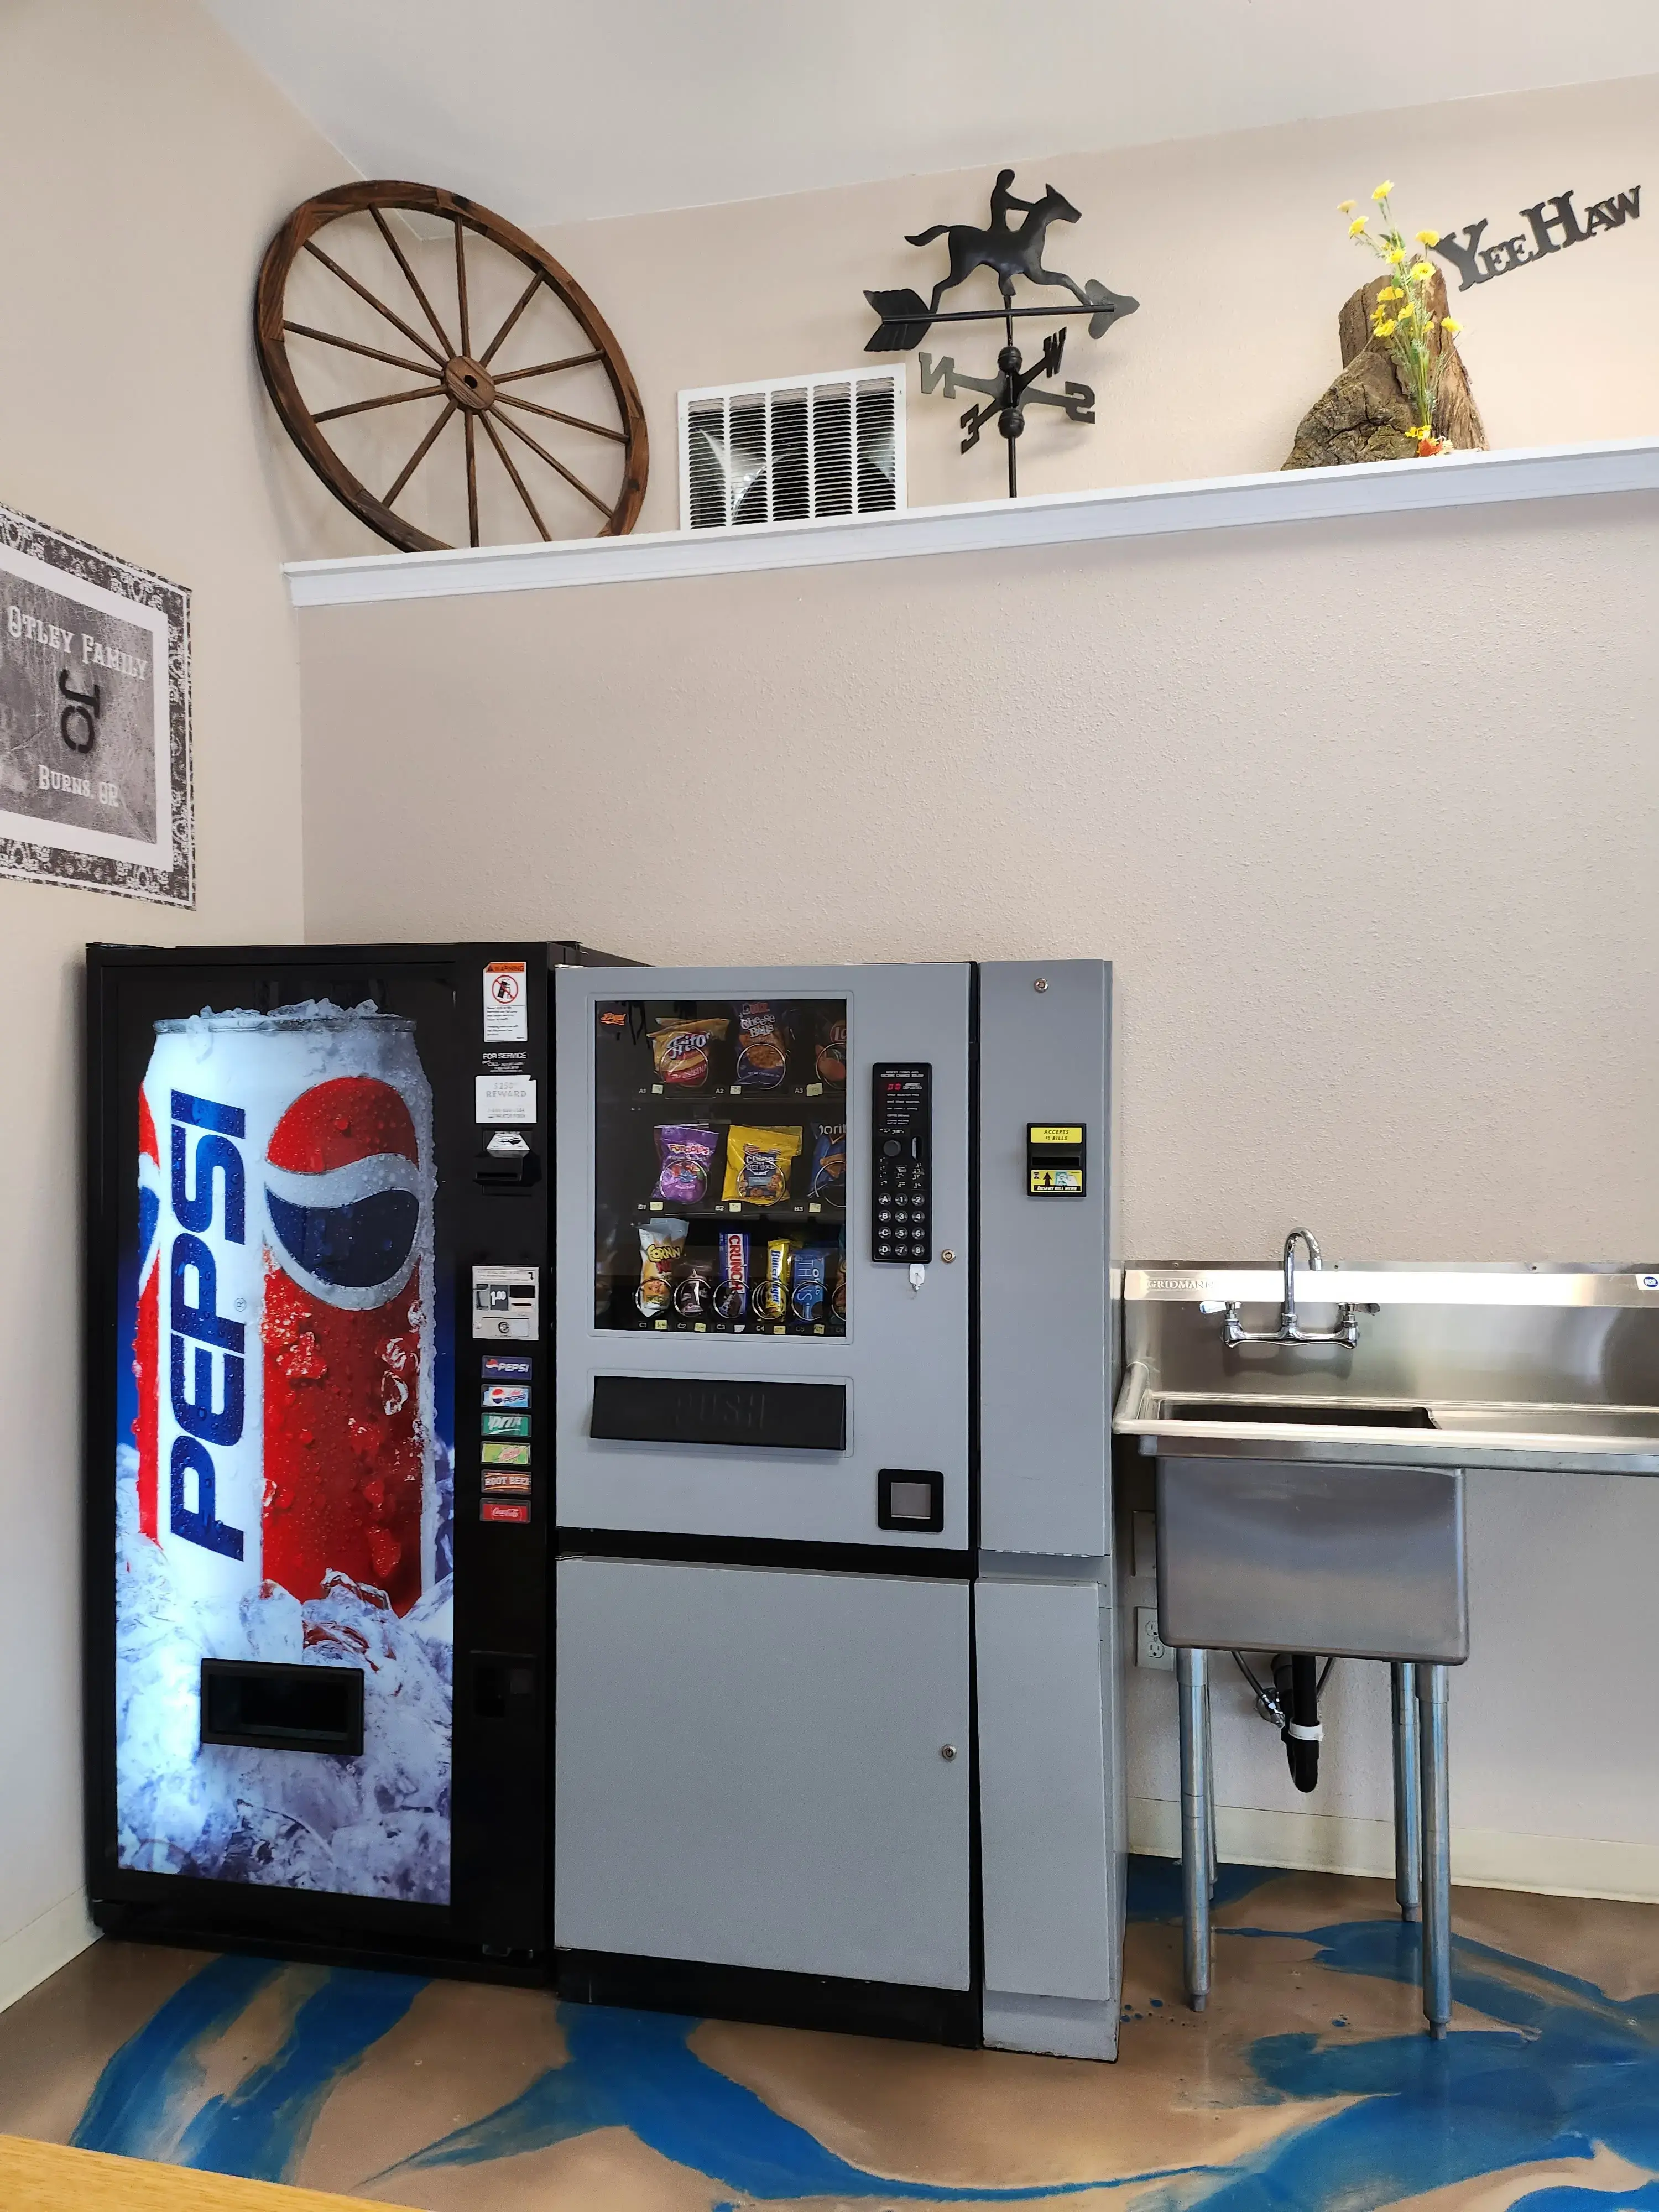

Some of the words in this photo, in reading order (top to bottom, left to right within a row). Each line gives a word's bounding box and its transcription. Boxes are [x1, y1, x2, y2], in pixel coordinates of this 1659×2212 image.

[7, 605, 75, 653] OTLEY
[81, 633, 148, 681] FAMILY
[740, 1015, 775, 1030] Cheese
[749, 1025, 774, 1037] Balls
[728, 1235, 743, 1293] CRUNCH
[797, 1259, 814, 1301] THINS
[1147, 1279, 1213, 1290] GRIDMANN
[171, 1088, 246, 1562] PEPSI
[498, 1363, 529, 1373] PEPSI
